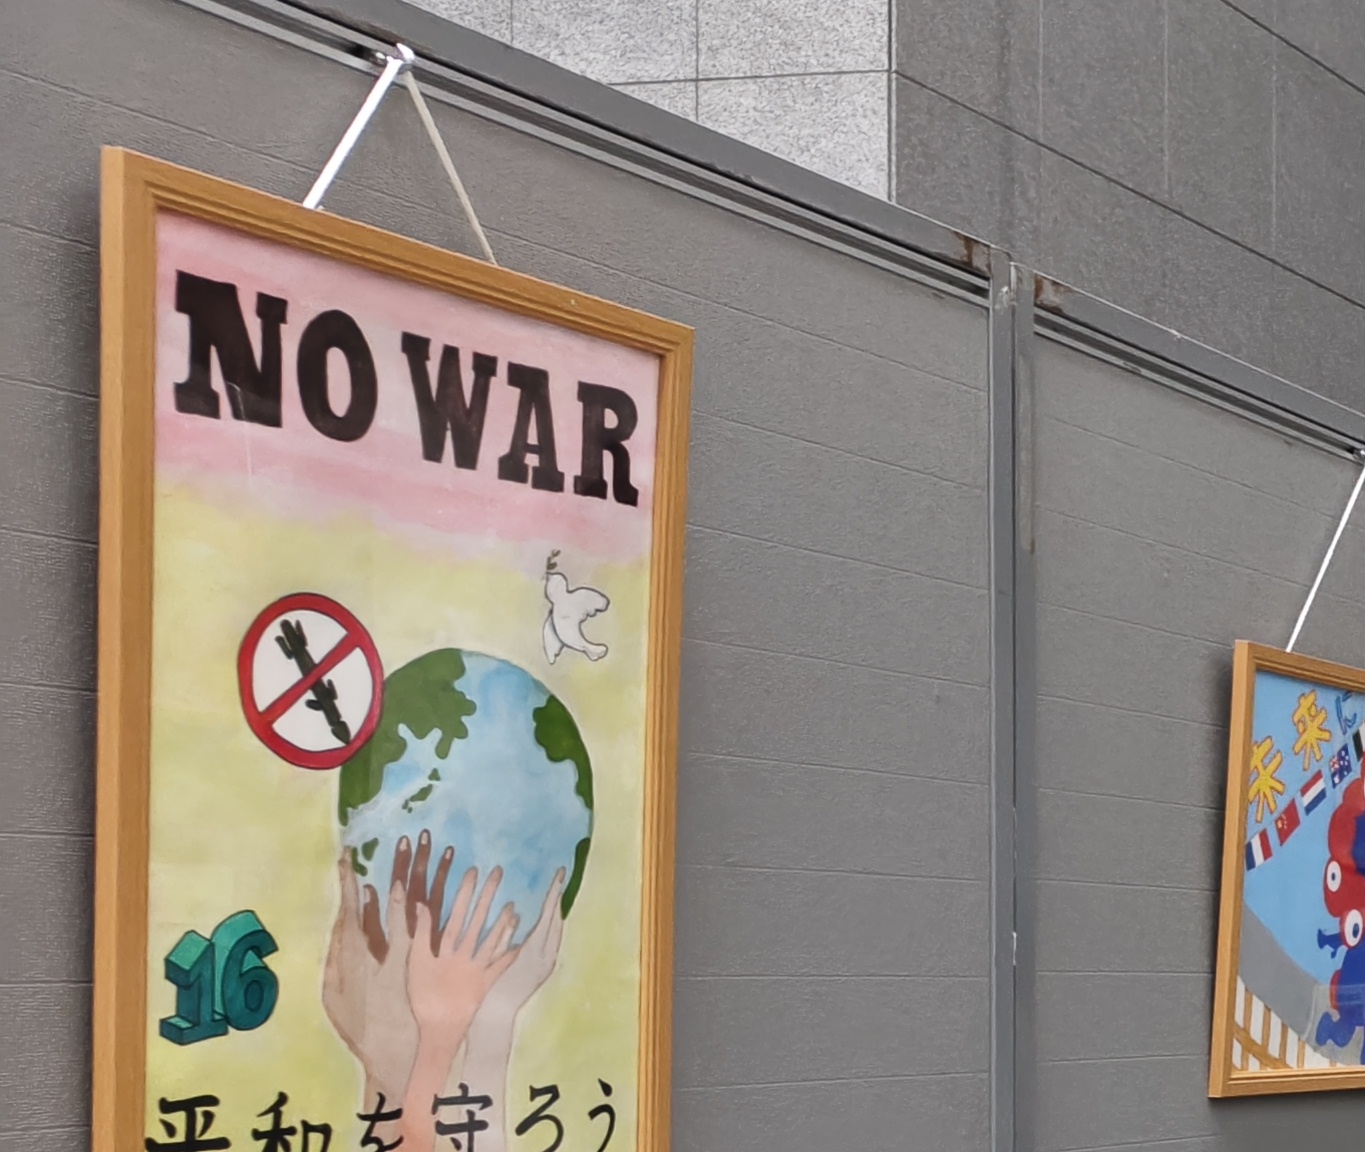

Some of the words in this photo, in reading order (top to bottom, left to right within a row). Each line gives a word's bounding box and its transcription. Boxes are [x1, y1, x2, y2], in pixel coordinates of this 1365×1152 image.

[173, 269, 379, 442] NO
[400, 331, 640, 507] WAR
[159, 909, 280, 1046] 16
